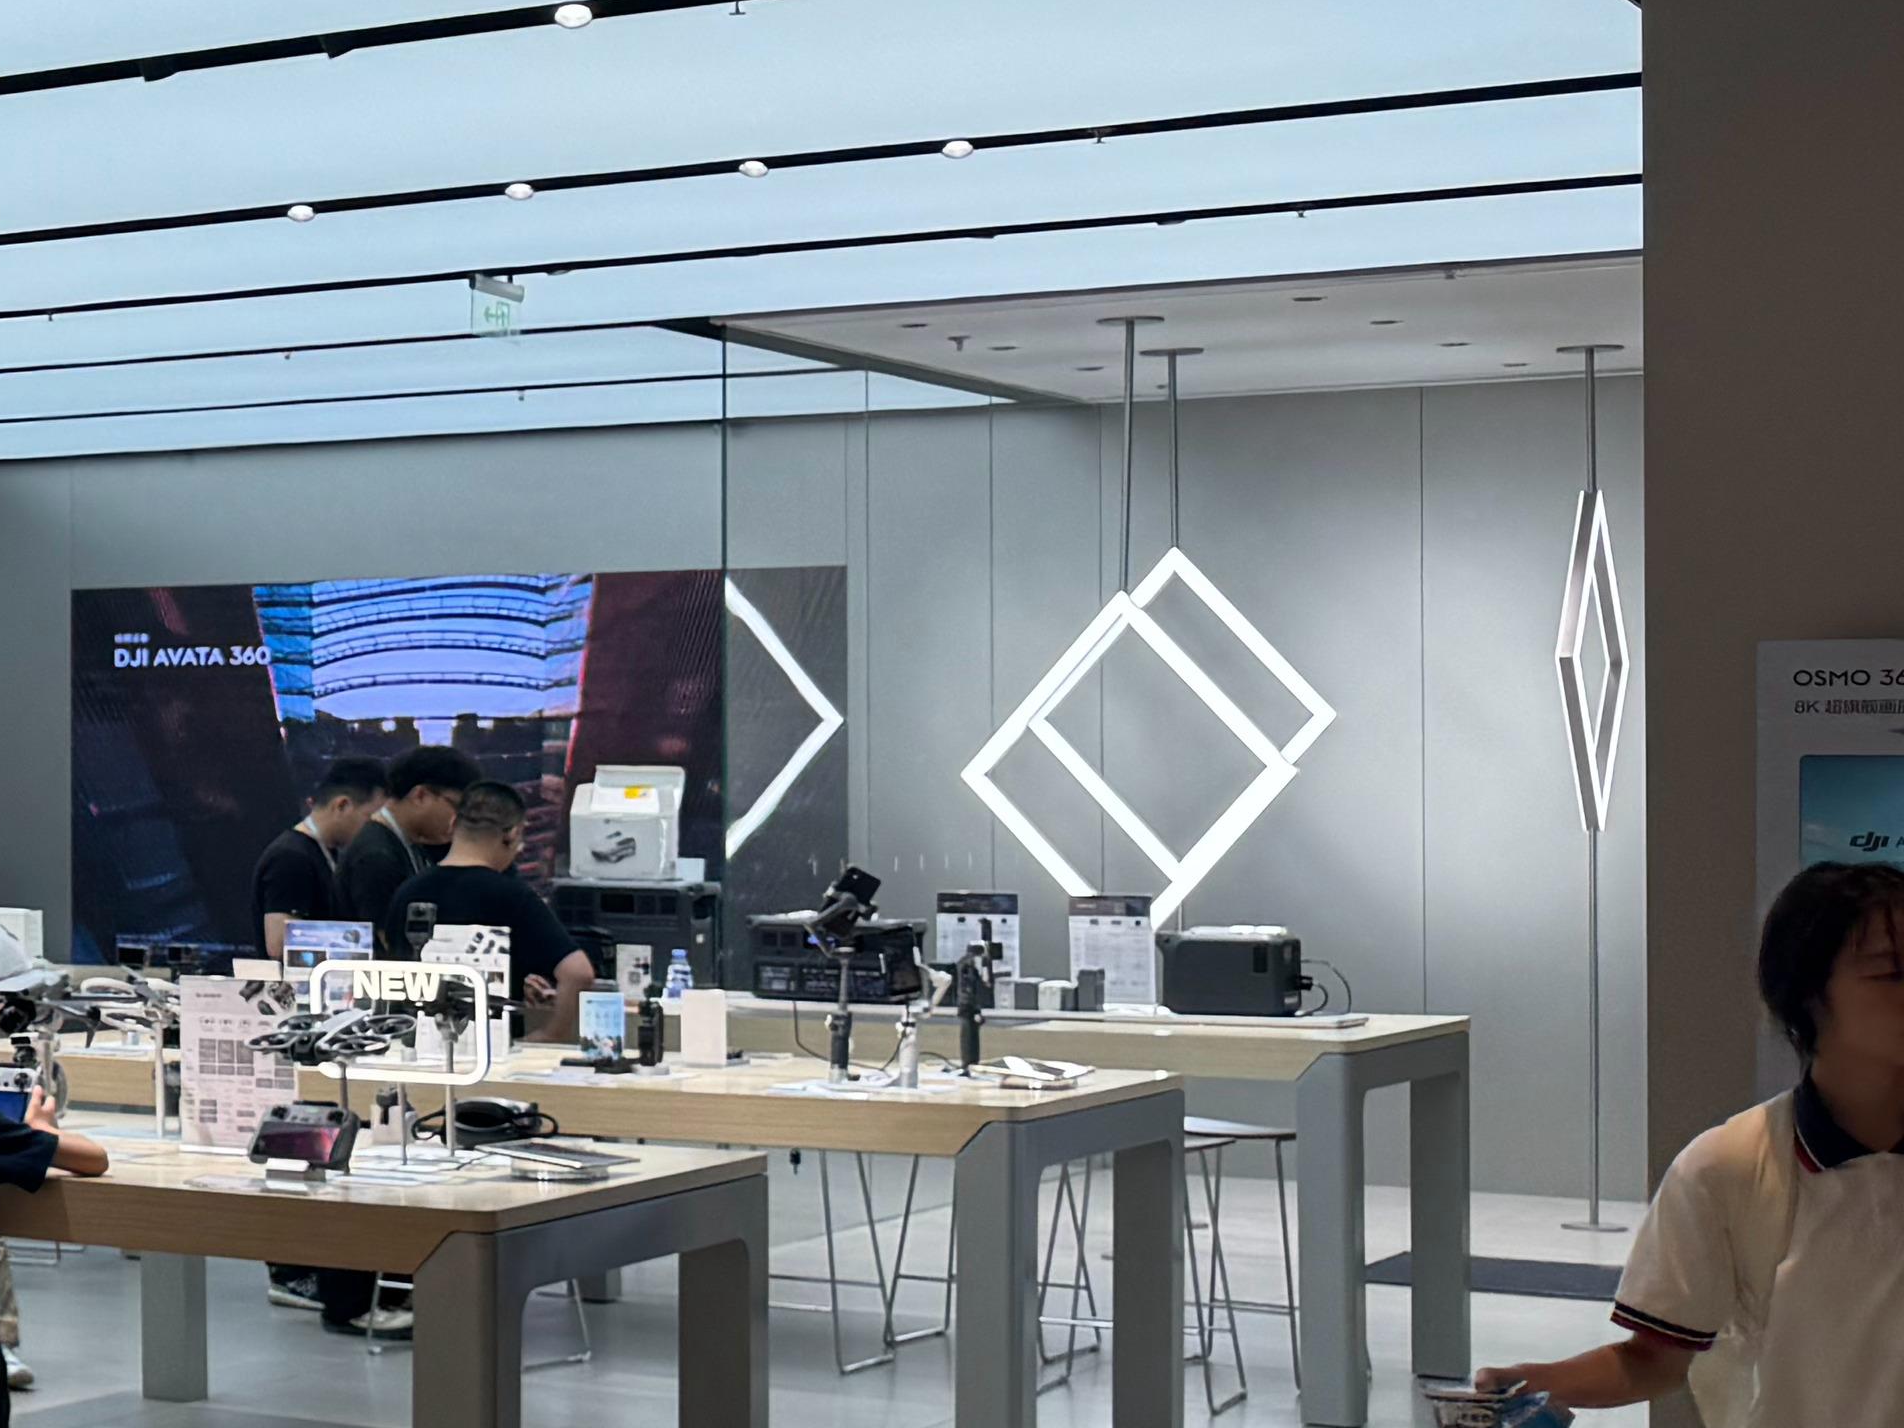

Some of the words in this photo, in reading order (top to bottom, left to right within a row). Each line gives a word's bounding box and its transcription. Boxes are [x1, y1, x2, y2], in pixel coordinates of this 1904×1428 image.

[114, 648, 149, 668] DJI
[153, 647, 225, 667] AVATA
[229, 645, 272, 666] 360
[1793, 669, 1871, 687] OSMO
[1794, 699, 1820, 714] 8K
[353, 970, 441, 1002] NEW
